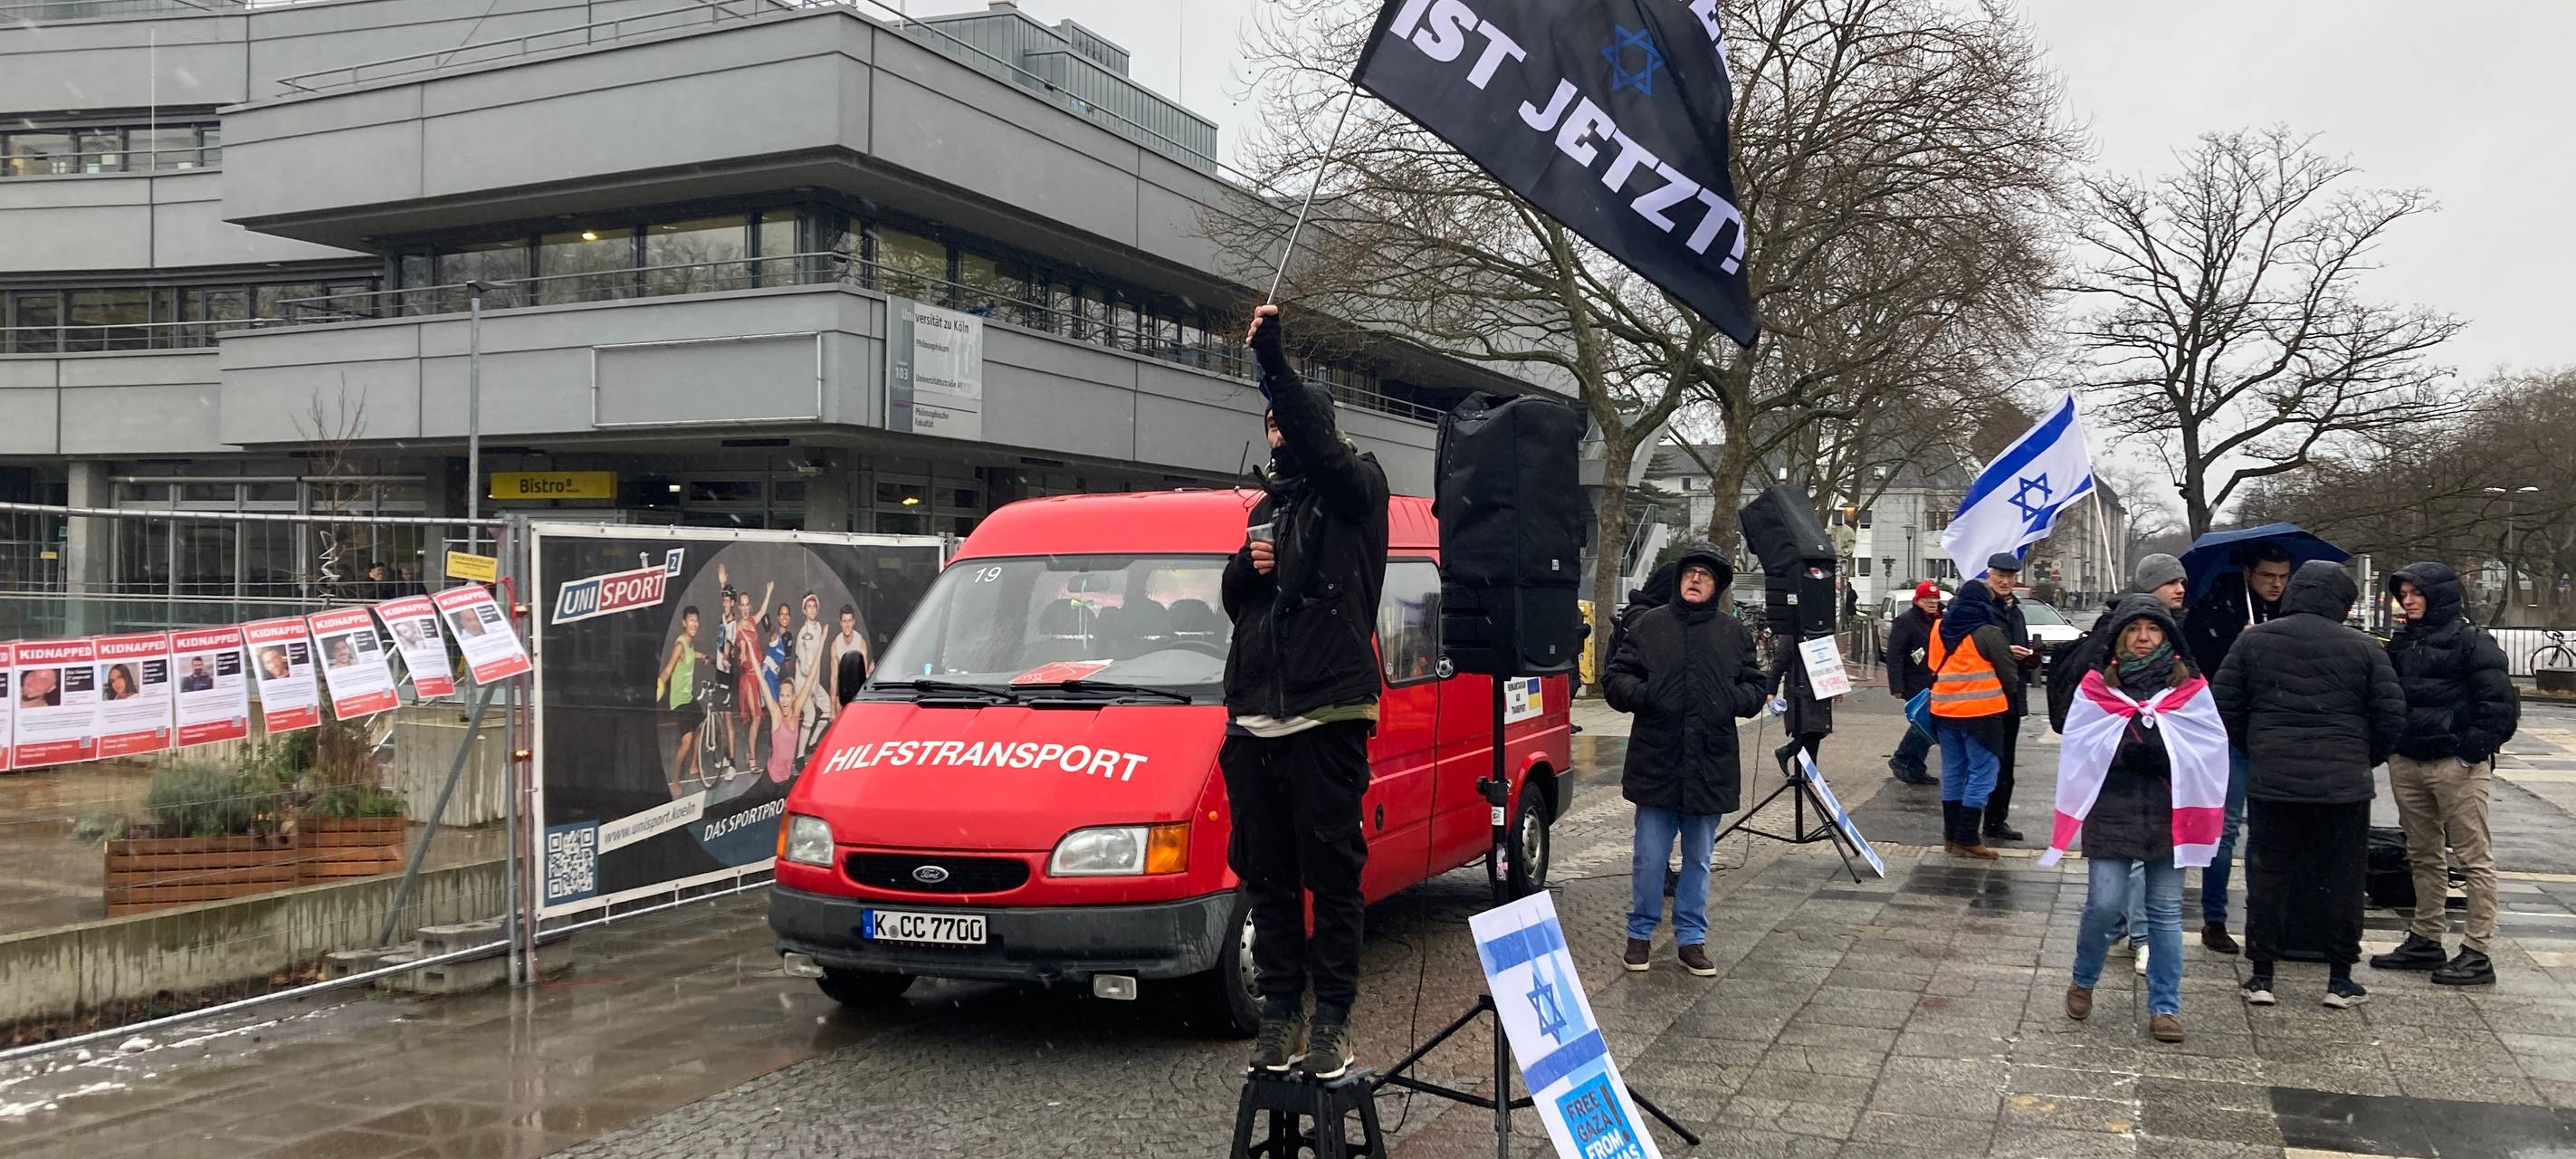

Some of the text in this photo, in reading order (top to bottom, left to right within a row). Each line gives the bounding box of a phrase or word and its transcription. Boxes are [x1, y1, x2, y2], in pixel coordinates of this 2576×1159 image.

[1389, 0, 1527, 90] IST
[1518, 77, 1746, 275] JETZT!
[943, 321, 952, 330] zu
[954, 320, 969, 333] Köln
[895, 367, 909, 379] 103
[520, 478, 564, 493] Bistro
[974, 566, 1002, 583] 19
[441, 590, 492, 607] KIDNAPPED
[383, 602, 434, 618] KIDNAPPED
[315, 613, 368, 630] KIDNAPPED
[177, 633, 239, 648] KIDNAPPED
[250, 625, 305, 639] KIDNAPPED
[19, 646, 91, 660] KIDNAPPED
[100, 640, 167, 655] KIDNAPPED
[823, 740, 1148, 781] HILFSTRANSPORT
[604, 801, 696, 844] www.unisport.koeln
[703, 823, 727, 842] DAS
[920, 868, 940, 879] Ford
[874, 914, 886, 936] K
[901, 915, 925, 938] CC
[930, 917, 982, 942] 7700
[1565, 1089, 1601, 1122] FREE
[1585, 1127, 1625, 1159] FROM
